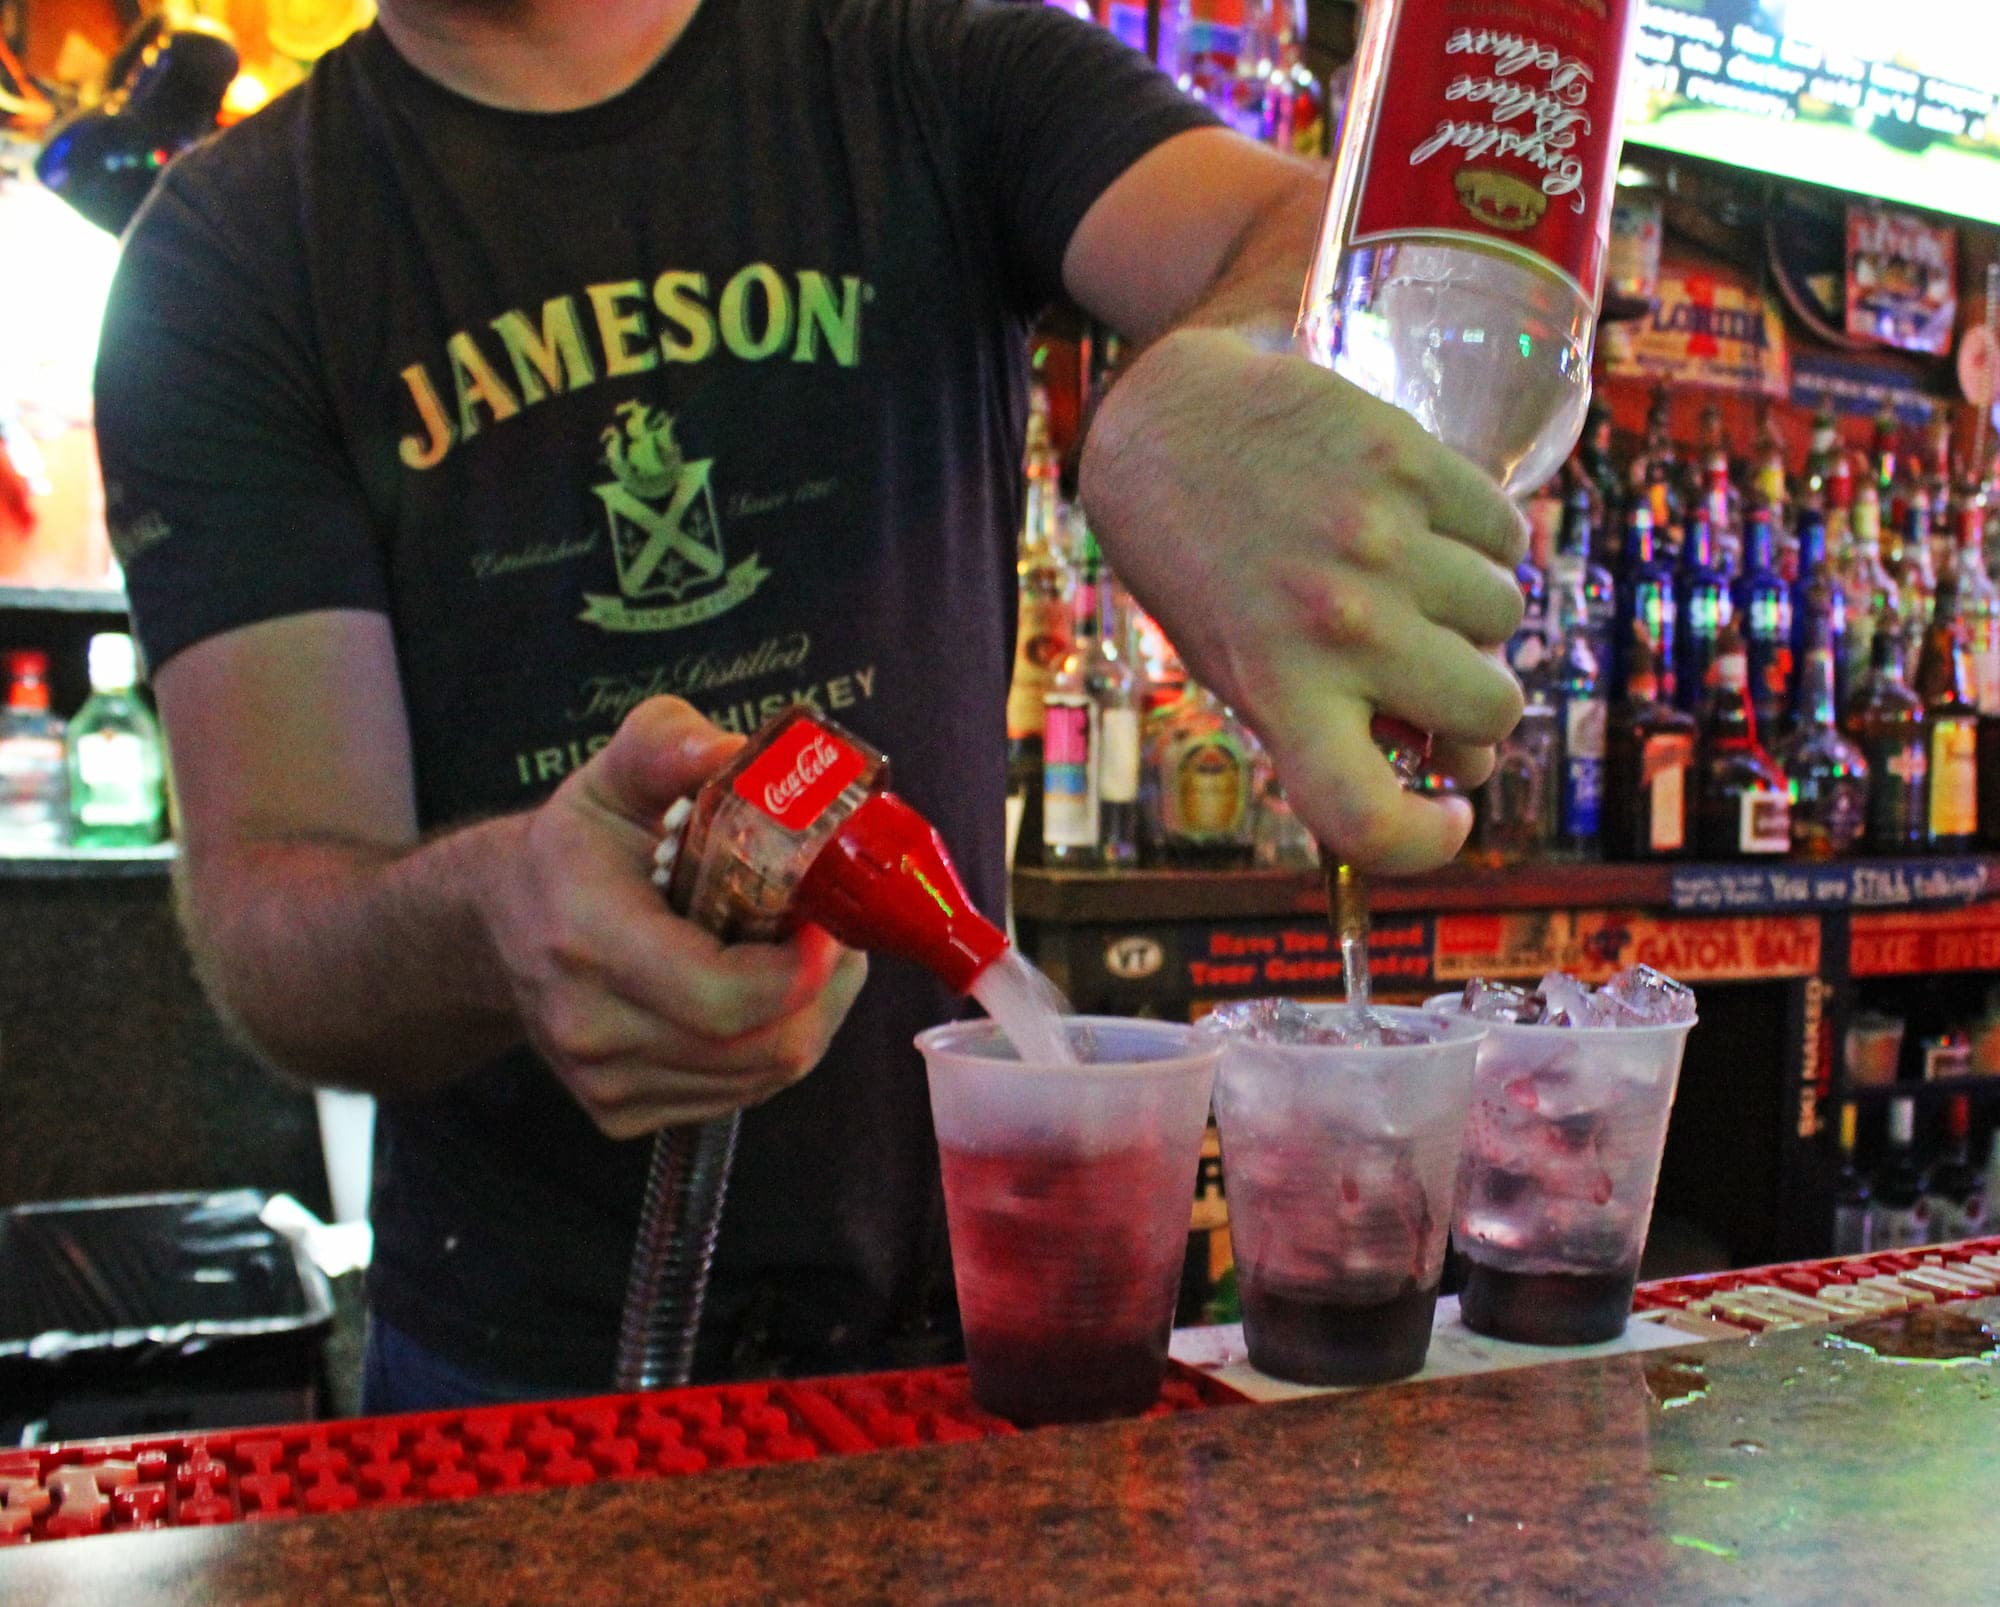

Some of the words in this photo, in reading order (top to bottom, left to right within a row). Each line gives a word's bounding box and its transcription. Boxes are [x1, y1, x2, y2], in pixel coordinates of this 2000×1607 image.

[1445, 27, 1594, 106] Deluxe
[1445, 75, 1592, 148] Palace
[1409, 119, 1586, 214] Crystal
[399, 263, 862, 470] JAMESON
[514, 733, 609, 785] IRIS
[1637, 931, 1742, 970] GATOR
